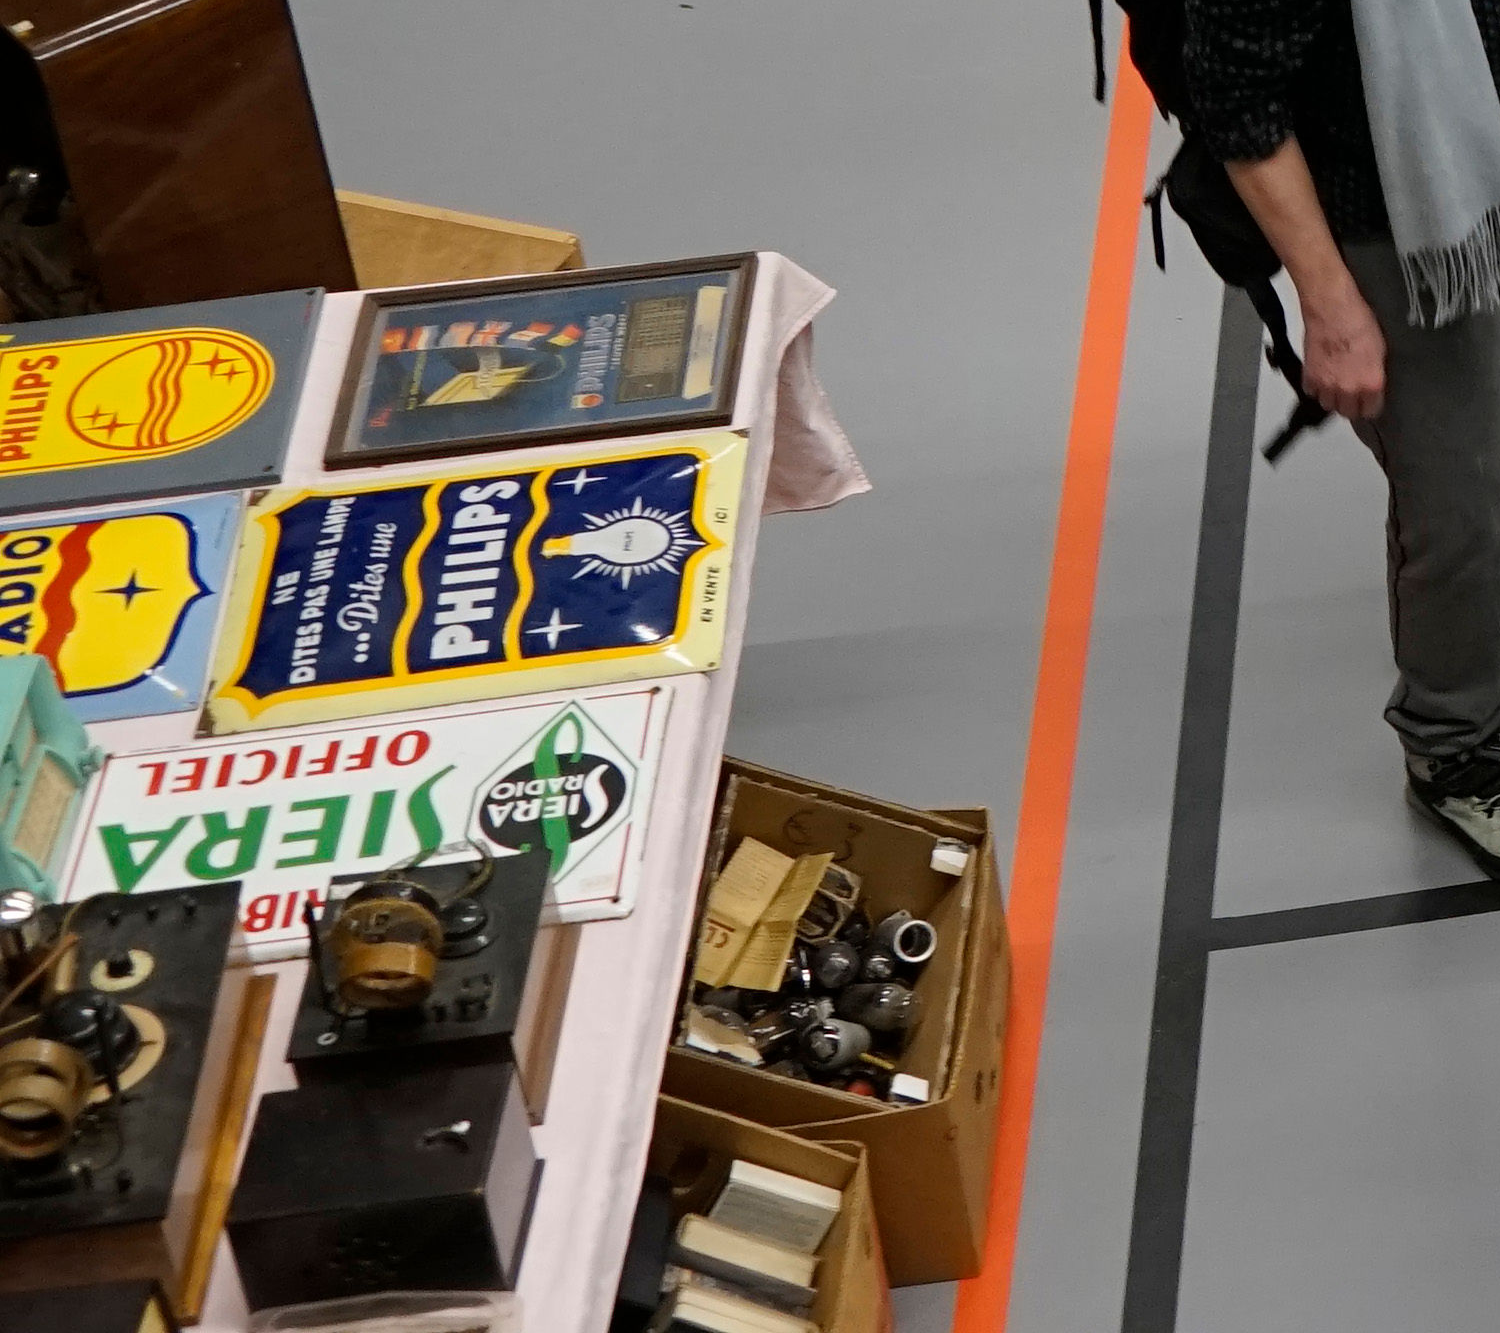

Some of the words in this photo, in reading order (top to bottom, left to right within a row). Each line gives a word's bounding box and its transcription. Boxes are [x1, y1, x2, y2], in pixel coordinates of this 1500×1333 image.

[578, 314, 616, 395] PHILIPS
[0, 354, 60, 462] PHILIPS
[316, 496, 357, 546] LAMPE
[715, 503, 730, 525] ICI
[308, 547, 340, 583] UNE
[369, 522, 398, 558] une
[0, 535, 52, 653] ADIO
[272, 570, 301, 606] NE
[429, 479, 521, 661] PHILIPS
[702, 564, 723, 601] VENTE
[299, 584, 331, 621] PAS
[699, 603, 717, 625] EN
[289, 621, 324, 685] DITES
[138, 729, 432, 798] OFFICIEL
[488, 773, 585, 802] RADIO
[488, 763, 610, 830] SIERA
[96, 763, 458, 895] SIERA
